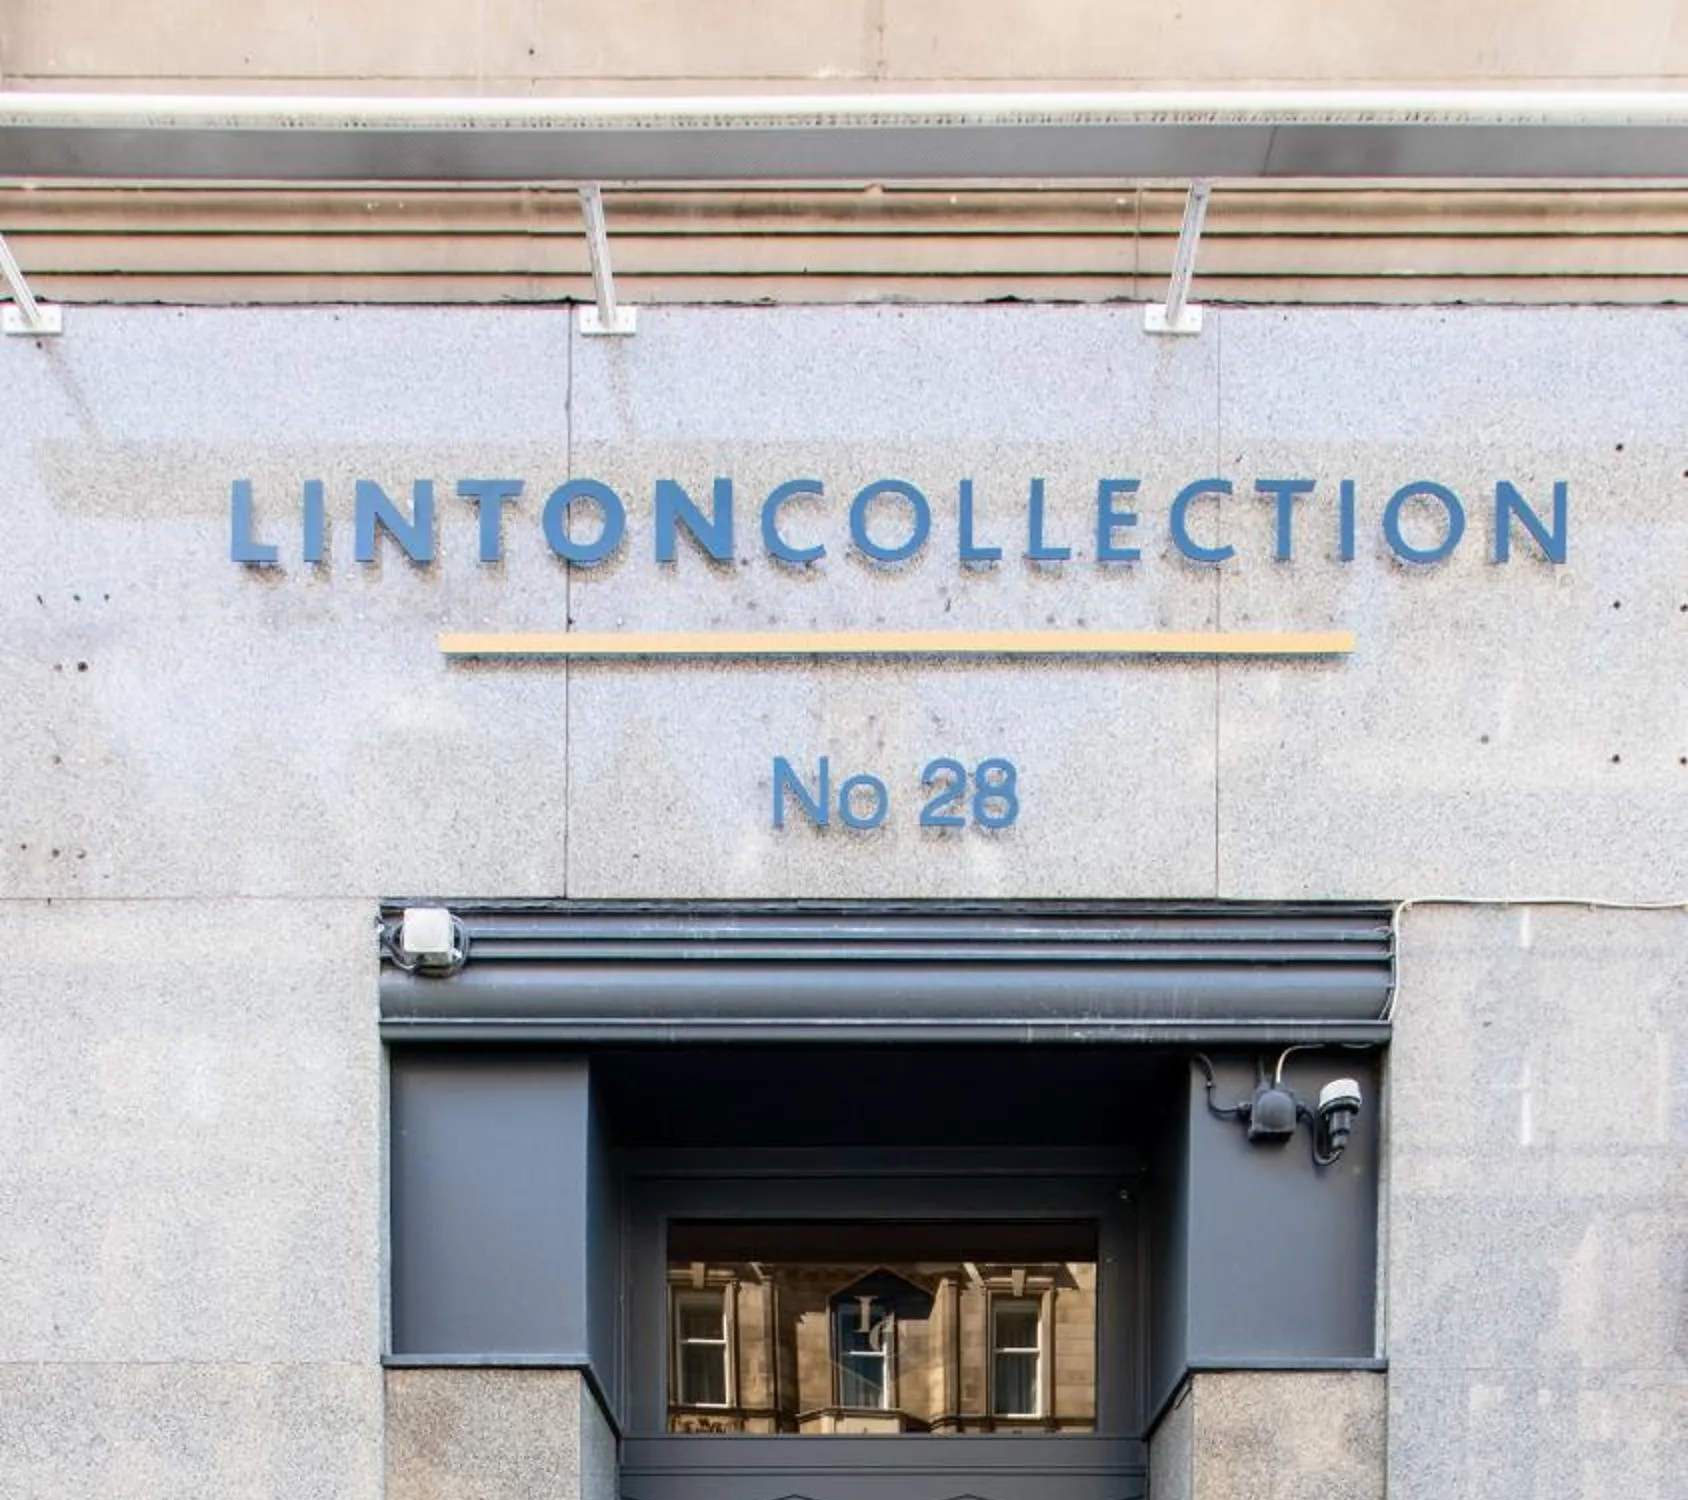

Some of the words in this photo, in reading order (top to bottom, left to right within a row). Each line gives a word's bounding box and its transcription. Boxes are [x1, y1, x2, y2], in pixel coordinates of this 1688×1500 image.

[232, 479, 1568, 565] LINTONCOLLECTION
[772, 756, 888, 830] No
[919, 756, 1021, 830] 28
